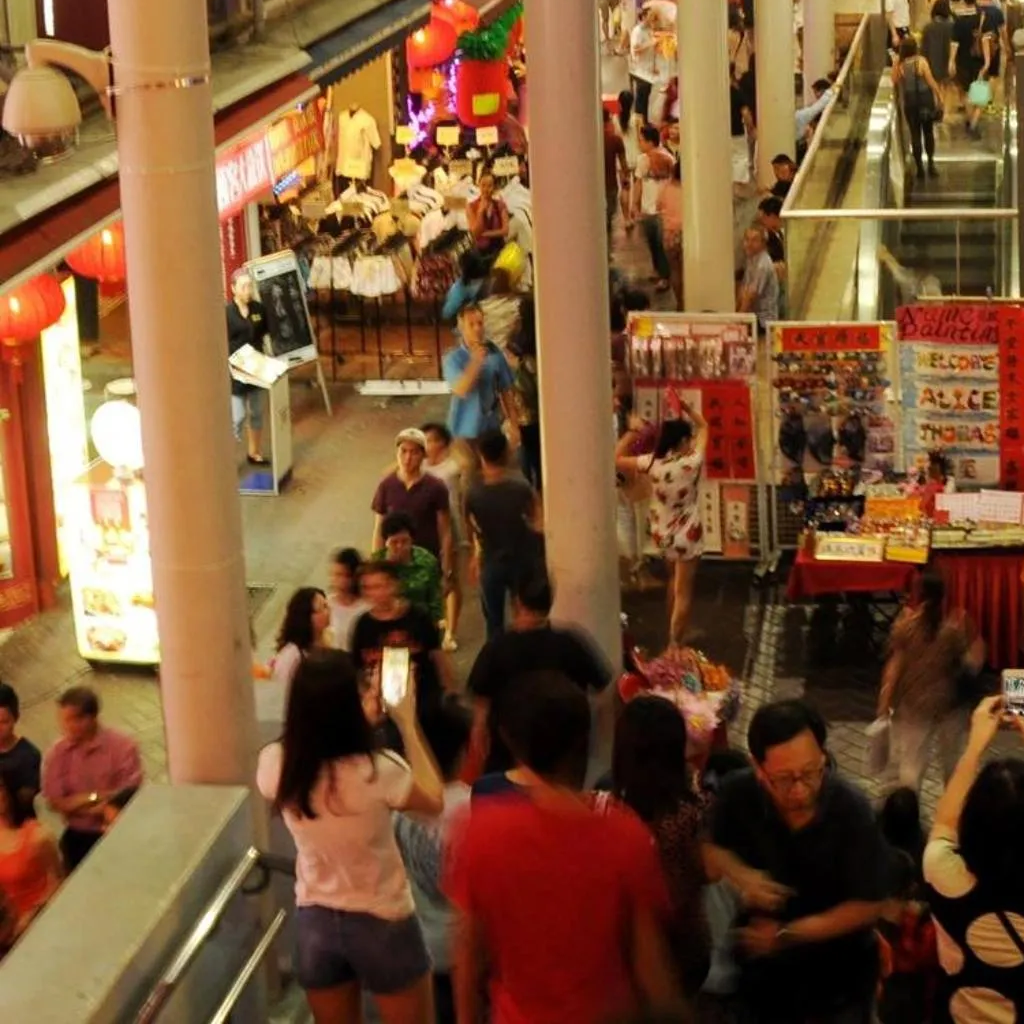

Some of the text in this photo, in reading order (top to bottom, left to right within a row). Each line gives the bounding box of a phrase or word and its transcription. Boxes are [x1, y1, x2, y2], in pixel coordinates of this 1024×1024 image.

[917, 350, 999, 373] WELCOME
[919, 386, 998, 411] ALICE
[920, 424, 998, 446] THOMAS
